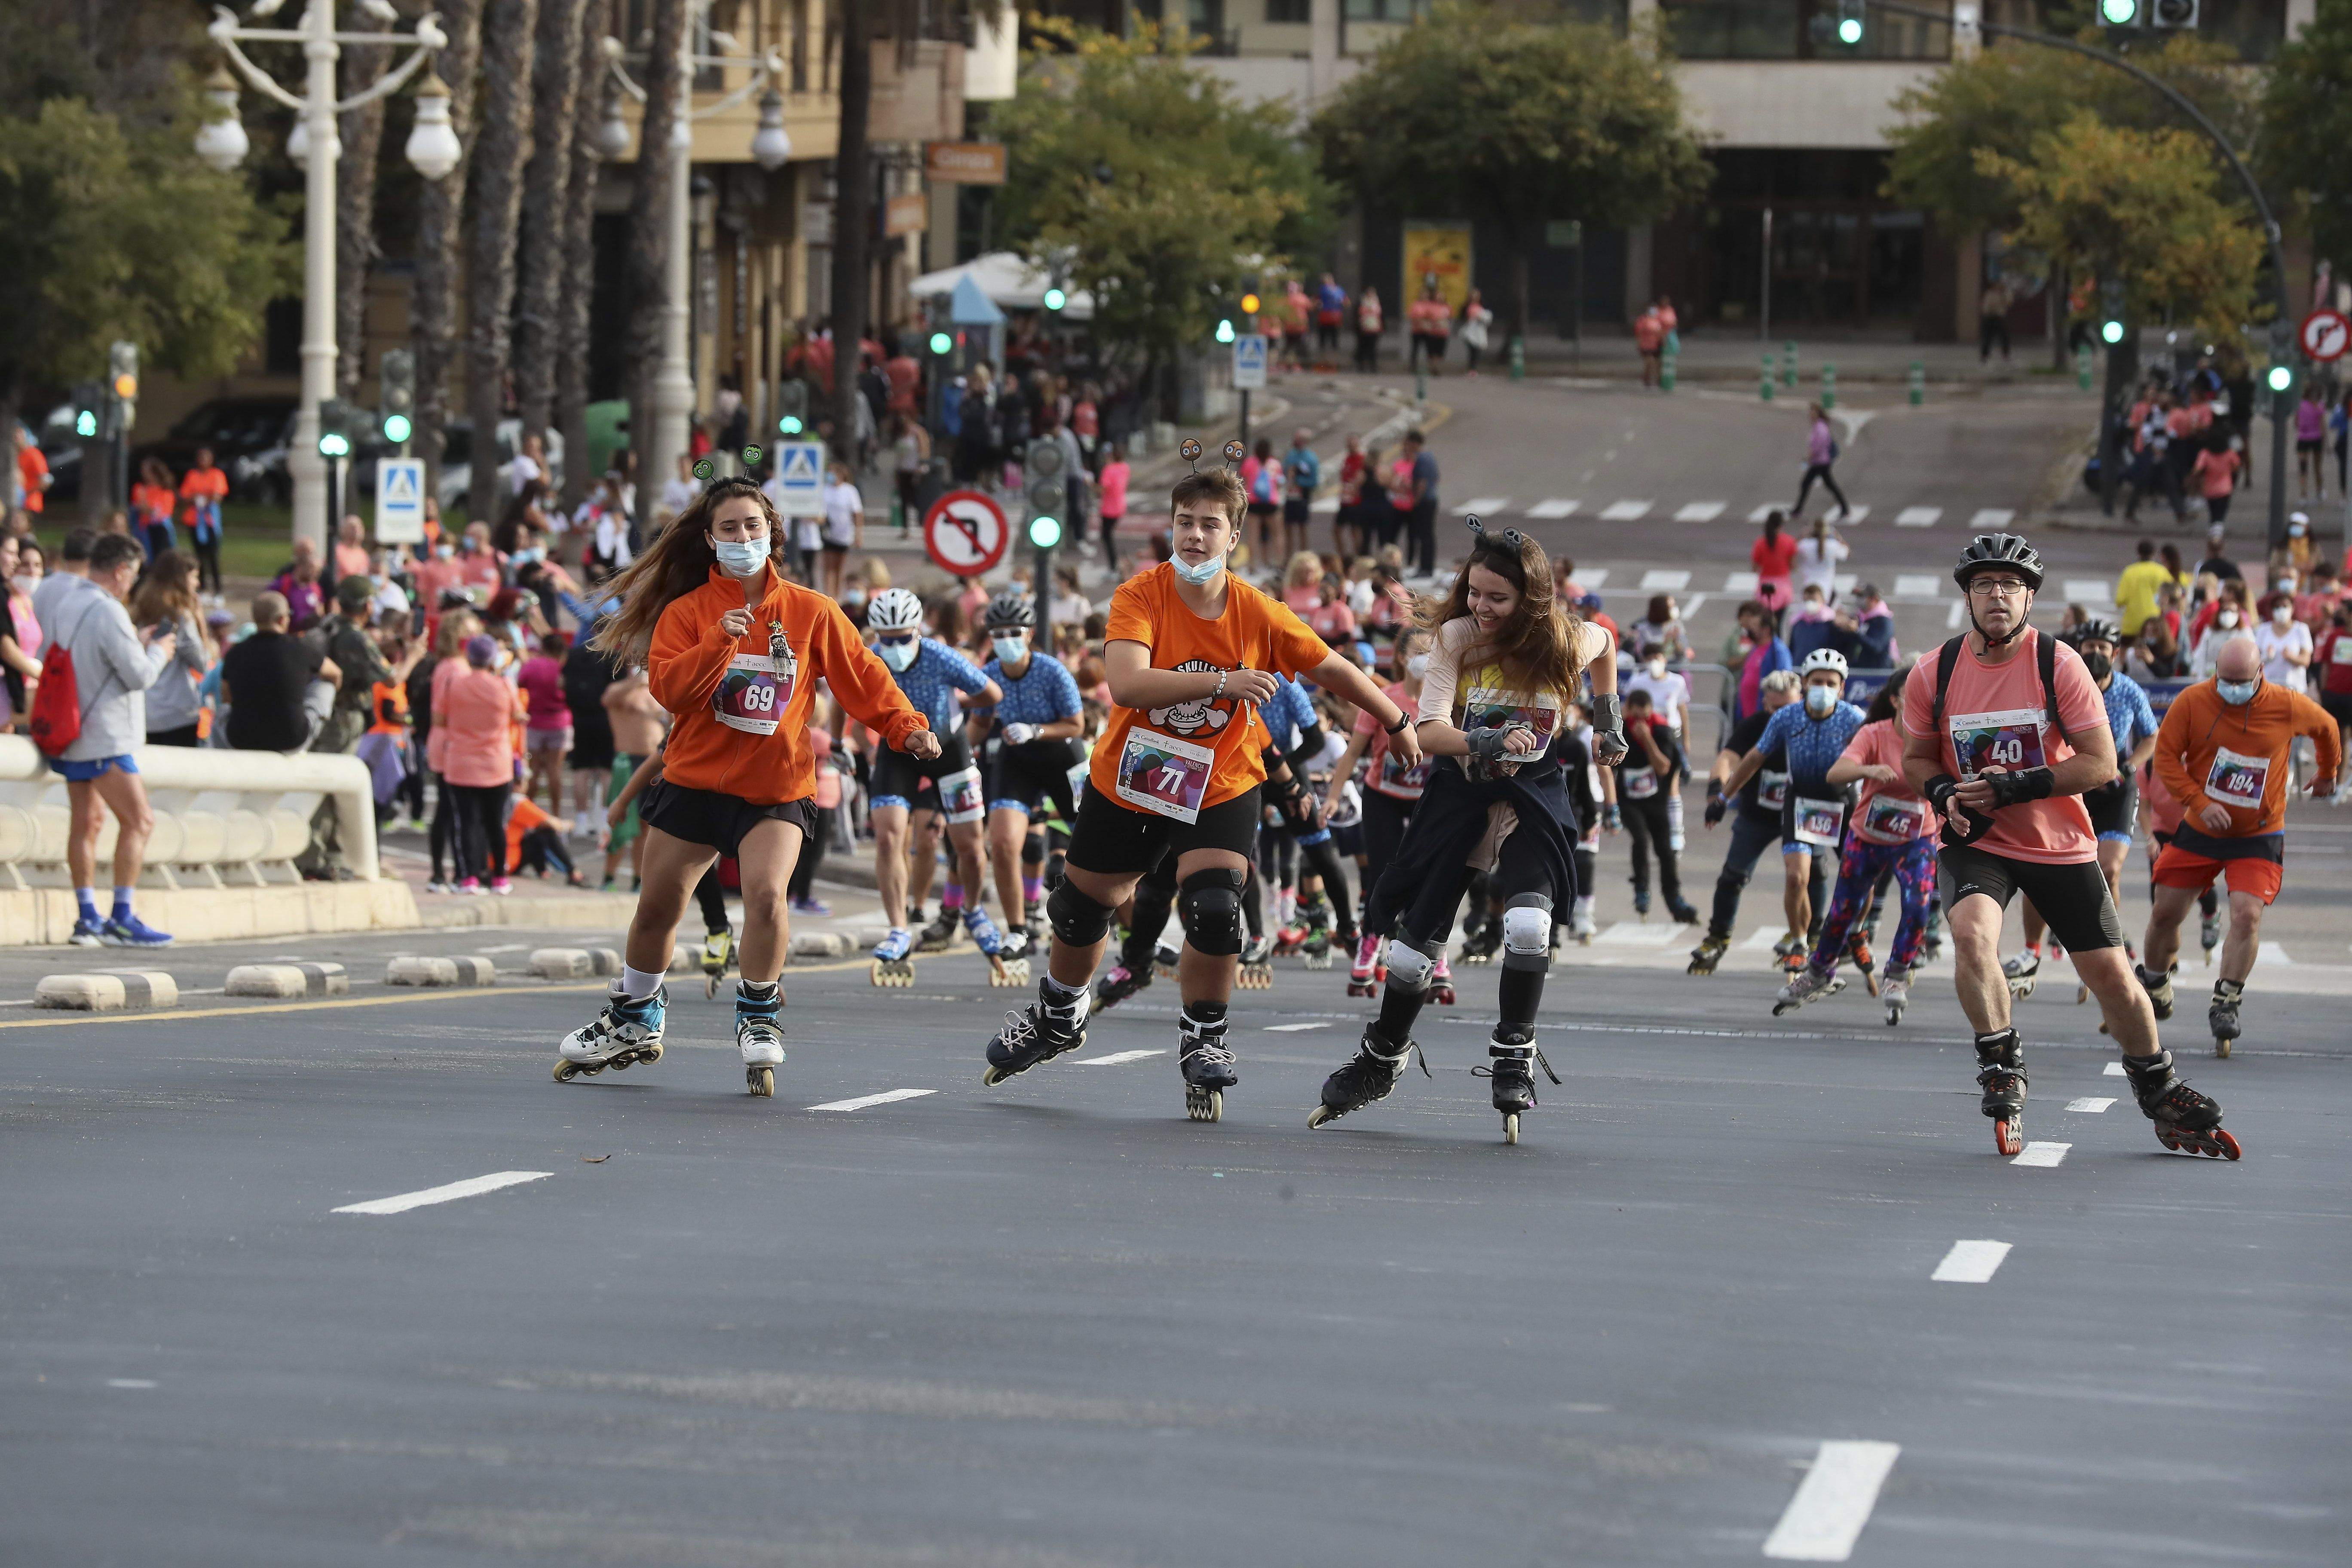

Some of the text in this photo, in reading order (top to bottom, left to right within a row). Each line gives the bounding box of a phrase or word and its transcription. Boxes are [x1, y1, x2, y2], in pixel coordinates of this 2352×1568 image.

[1177, 661, 1216, 673] SKULLS
[744, 685, 775, 712] 69
[1141, 735, 1159, 744] CaixaBank
[1992, 739, 2023, 765] 40
[1156, 765, 1185, 795] 71
[2228, 772, 2254, 793] 194
[1888, 815, 1911, 834] 45
